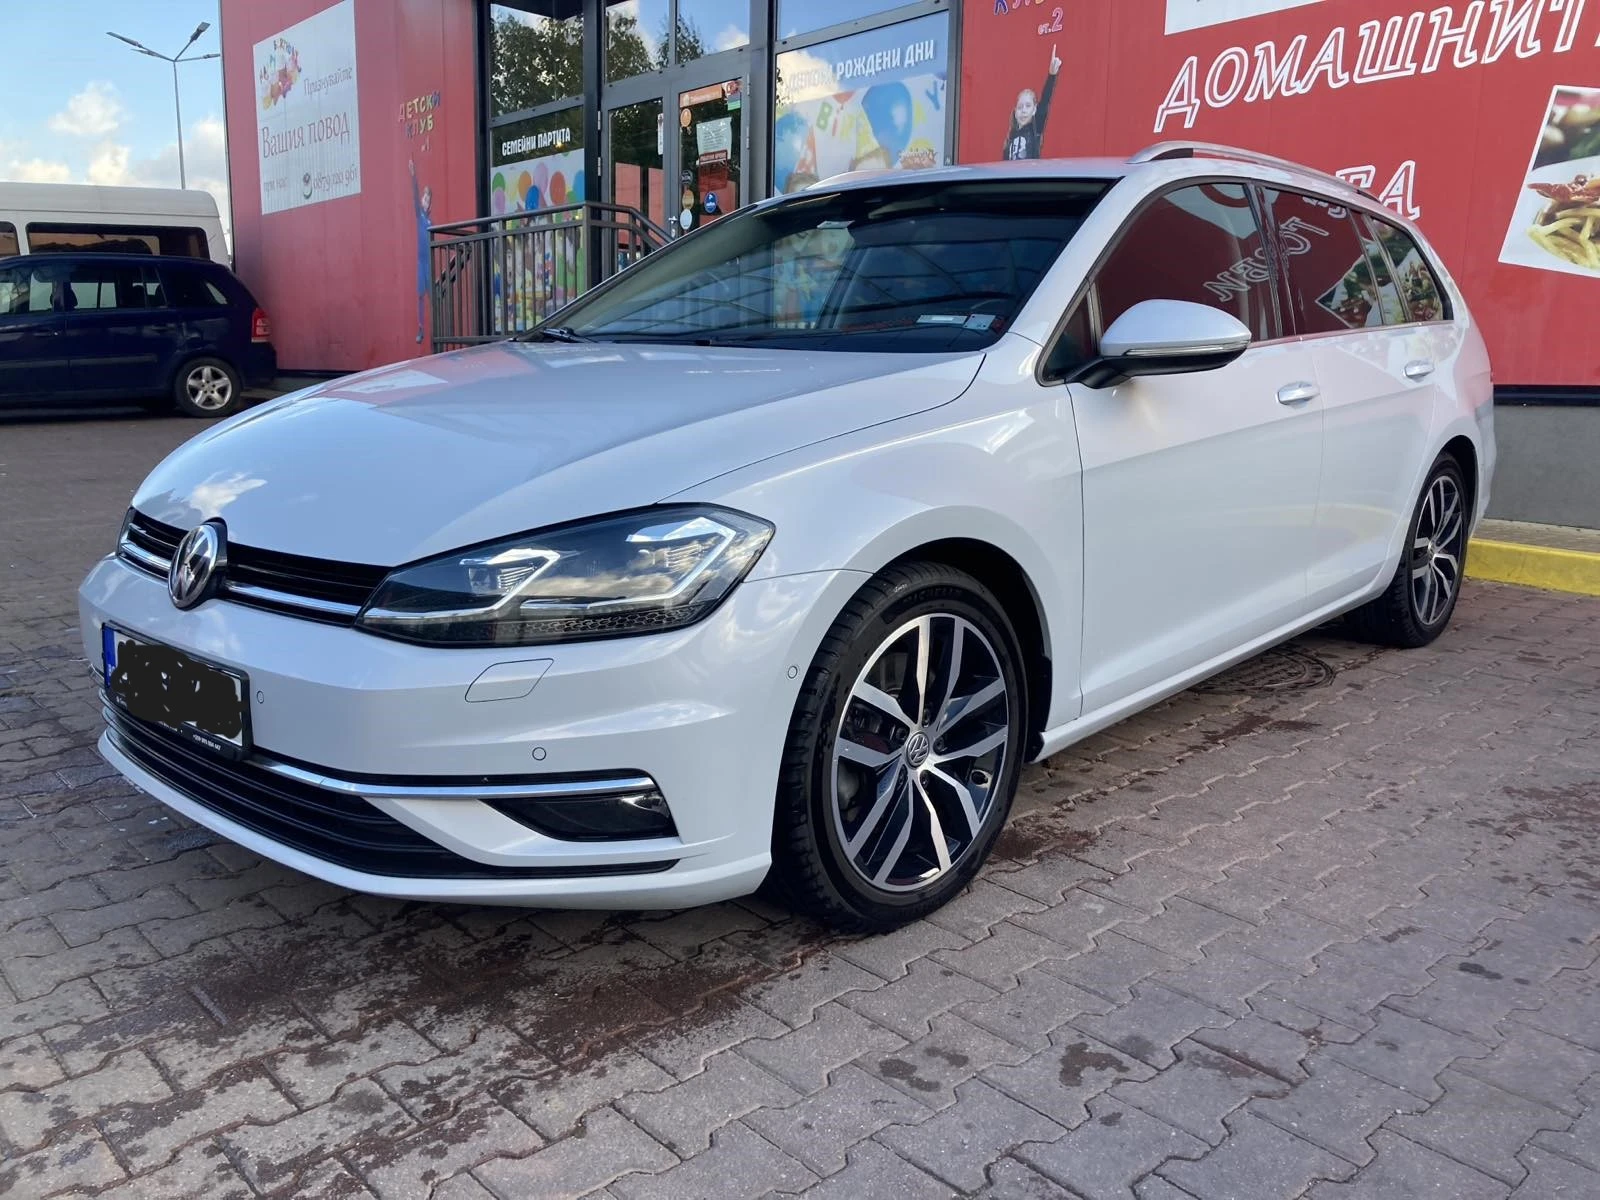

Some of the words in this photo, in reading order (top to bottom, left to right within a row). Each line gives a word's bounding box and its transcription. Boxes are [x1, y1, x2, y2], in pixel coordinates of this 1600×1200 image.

[836, 47, 901, 81] РОЖДЕНИ
[904, 39, 935, 68] ДНИ
[1153, 0, 1600, 133] ДОМАШНИТ
[398, 90, 441, 122] ДЕТСКИ
[262, 126, 305, 158] Вашия
[308, 112, 350, 144] повод
[405, 114, 433, 139] КЛУБ
[502, 135, 537, 156] СЕМЕЙНИ
[537, 127, 571, 148] ПАРТИТА
